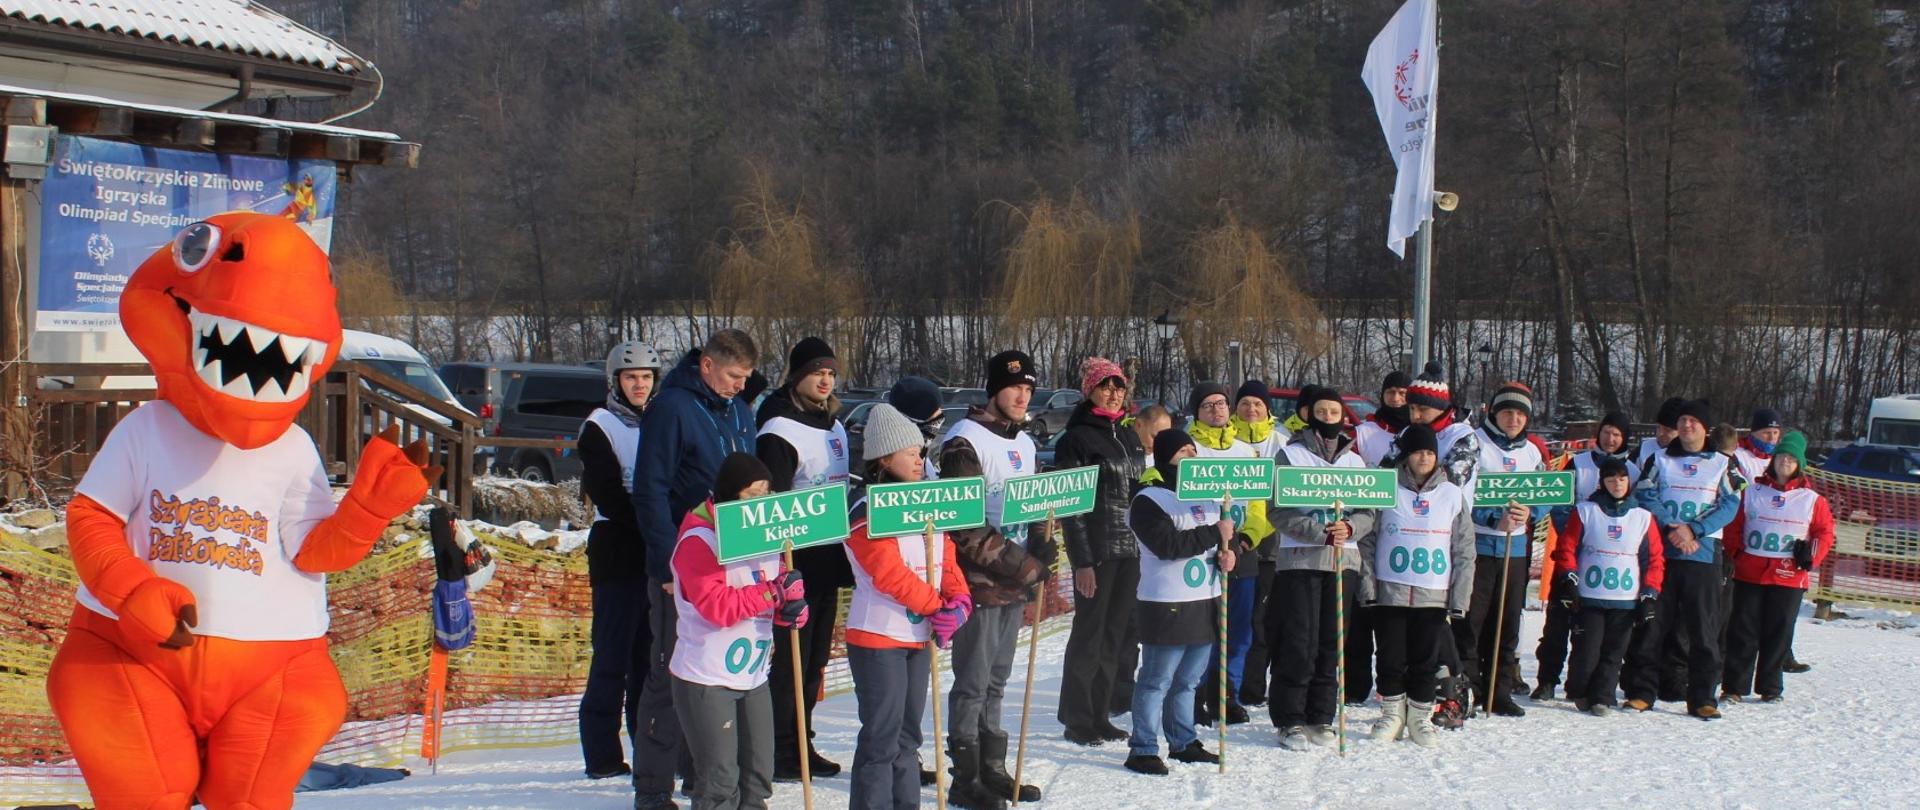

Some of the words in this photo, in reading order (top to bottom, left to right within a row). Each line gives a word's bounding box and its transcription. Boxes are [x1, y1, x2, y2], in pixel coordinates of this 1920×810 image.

[203, 173, 264, 192] Zimowe
[96, 186, 168, 206] Igrzyska
[59, 203, 128, 222] Olimpiad
[1190, 465, 1227, 478] TACY
[1233, 465, 1265, 477] SAMI
[1301, 473, 1376, 487] TORNADO
[1007, 471, 1096, 502] NIEPOKONANI
[1182, 480, 1270, 493] Skarżysko-Kam.
[1282, 487, 1392, 499] Skarżysko-Kam.
[874, 485, 980, 508] KRYSZTAŁKI
[1020, 496, 1080, 513] Sandomierz
[741, 492, 826, 529] MAAG
[902, 509, 957, 523] Kielce
[765, 524, 808, 542] Kielce
[1748, 530, 1795, 552] 082
[1389, 546, 1447, 575] 088
[1585, 565, 1633, 591] 086
[725, 637, 772, 674] 07
